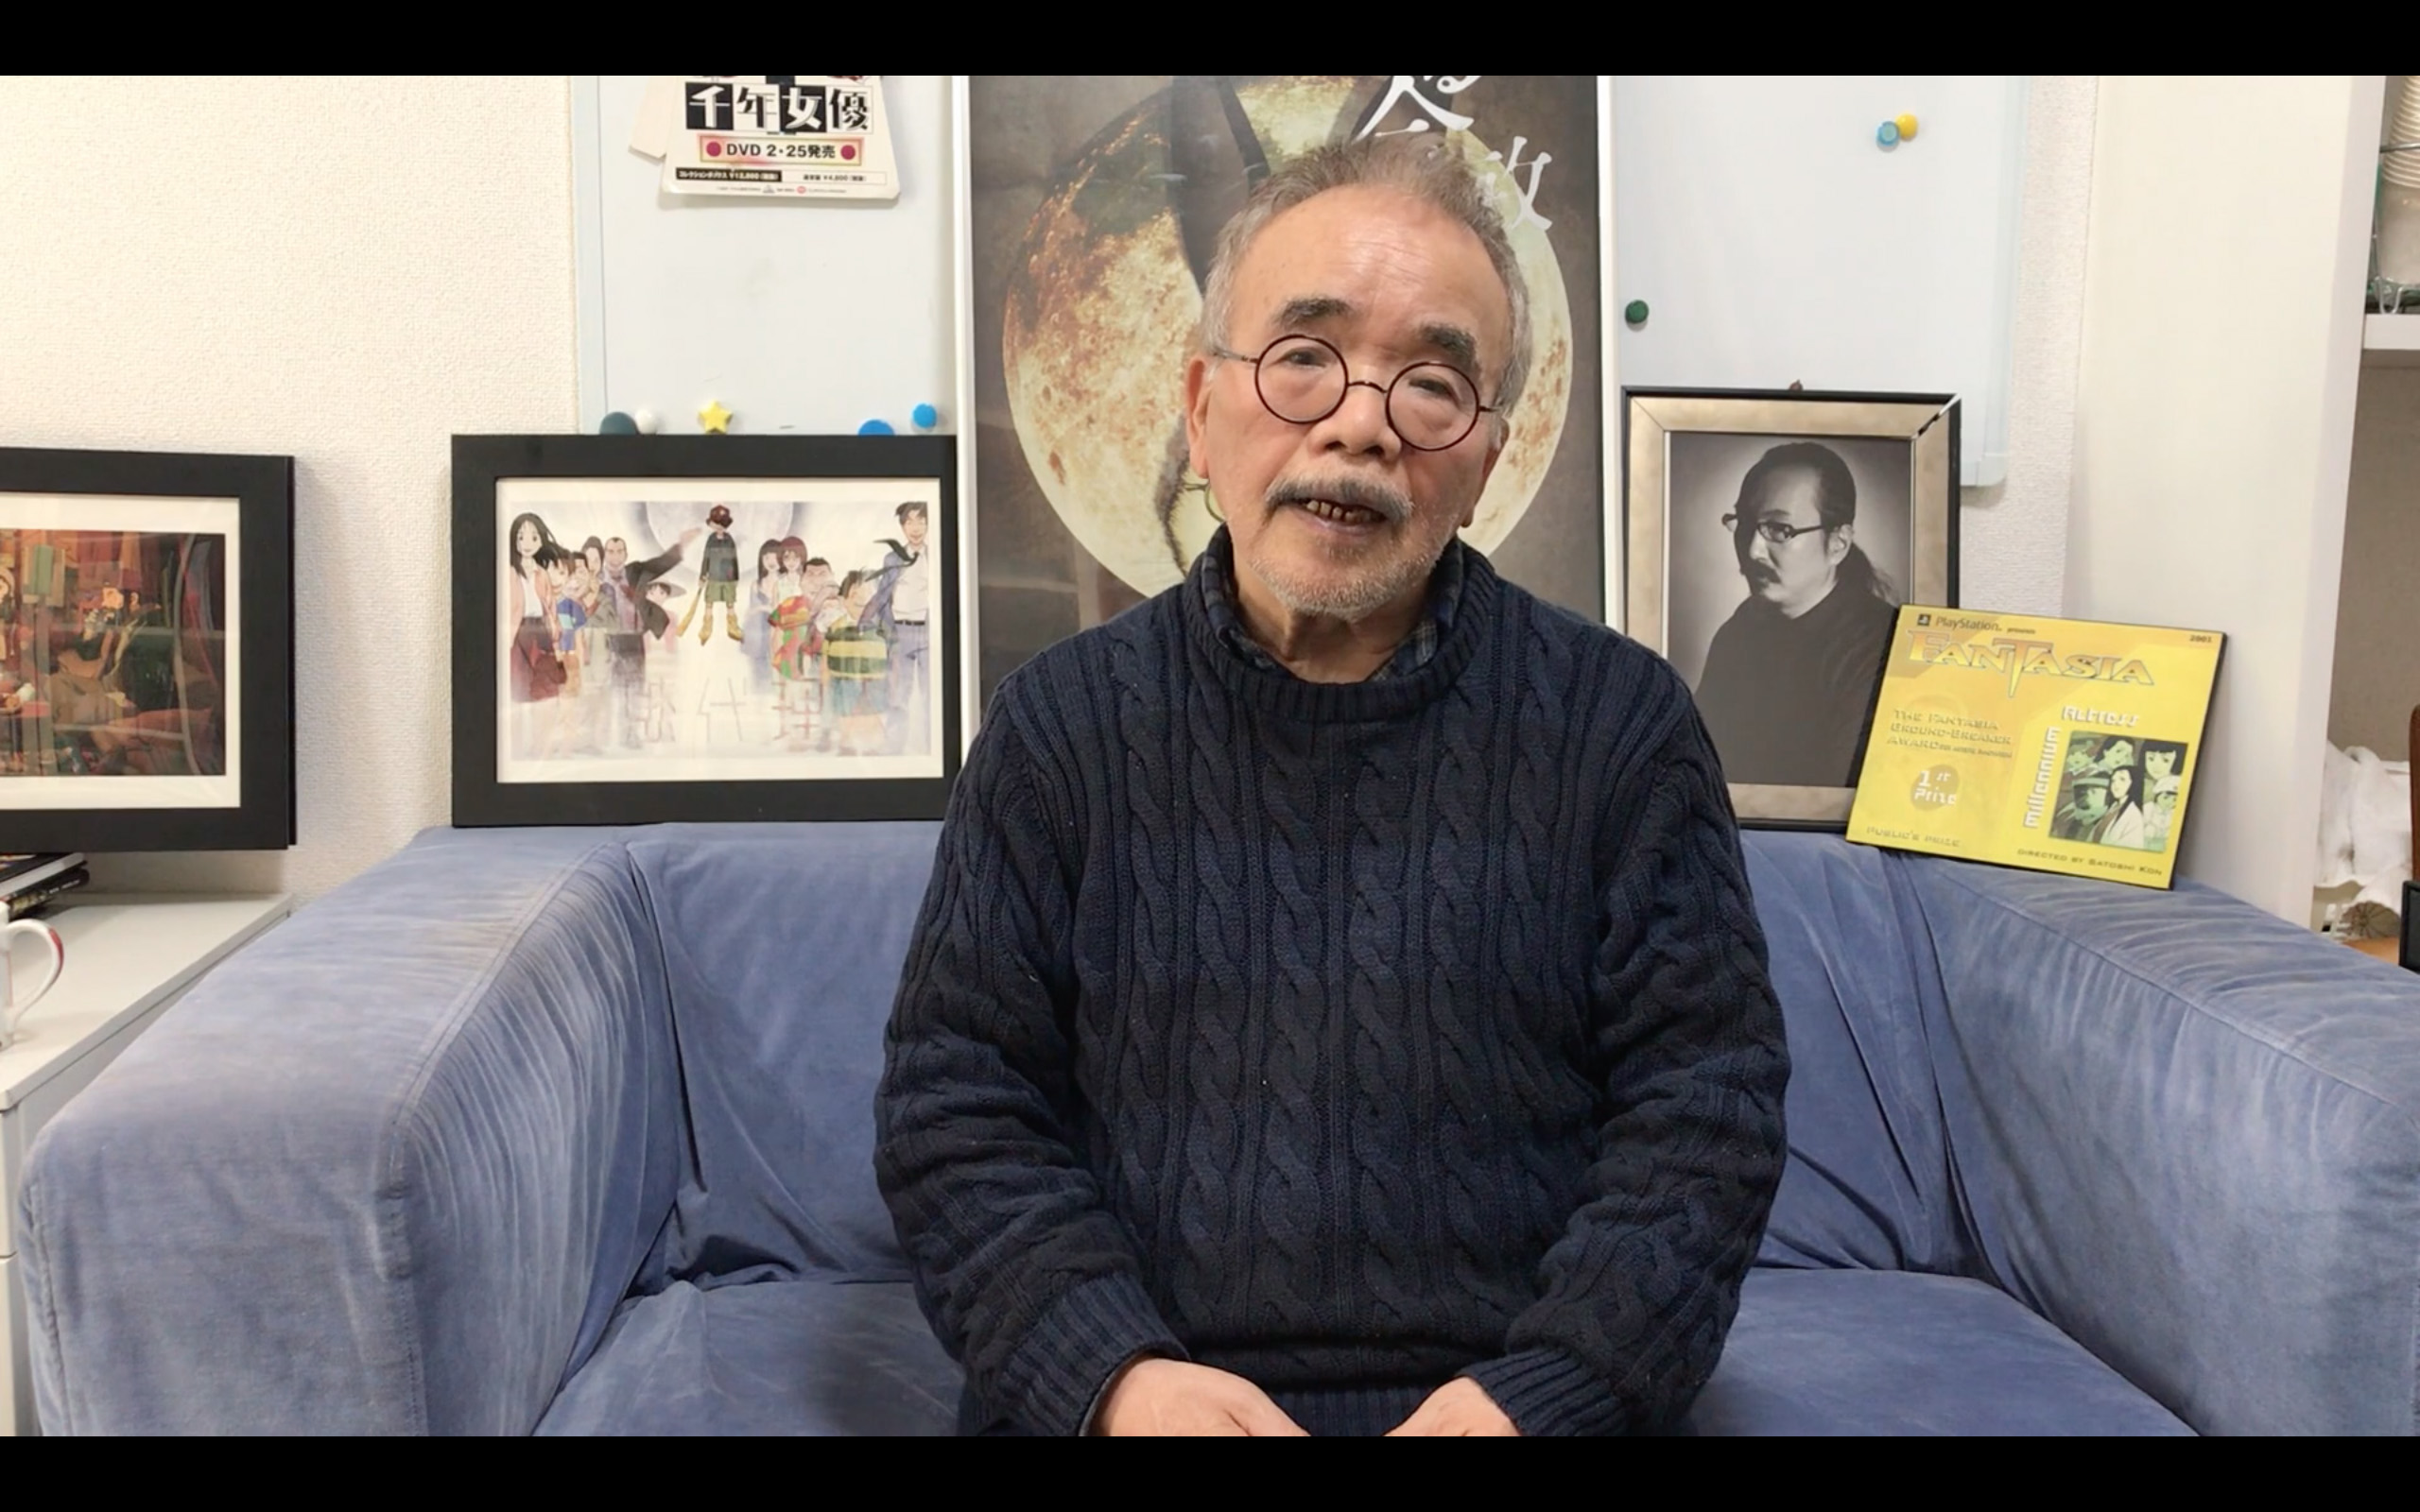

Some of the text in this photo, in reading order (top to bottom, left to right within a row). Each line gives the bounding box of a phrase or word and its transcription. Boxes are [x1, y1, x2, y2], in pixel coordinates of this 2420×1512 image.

[687, 85, 870, 130] 千年女優
[726, 143, 761, 157] DVD
[1906, 630, 2154, 698] FANTASIA
[1914, 786, 1957, 805] Prize
